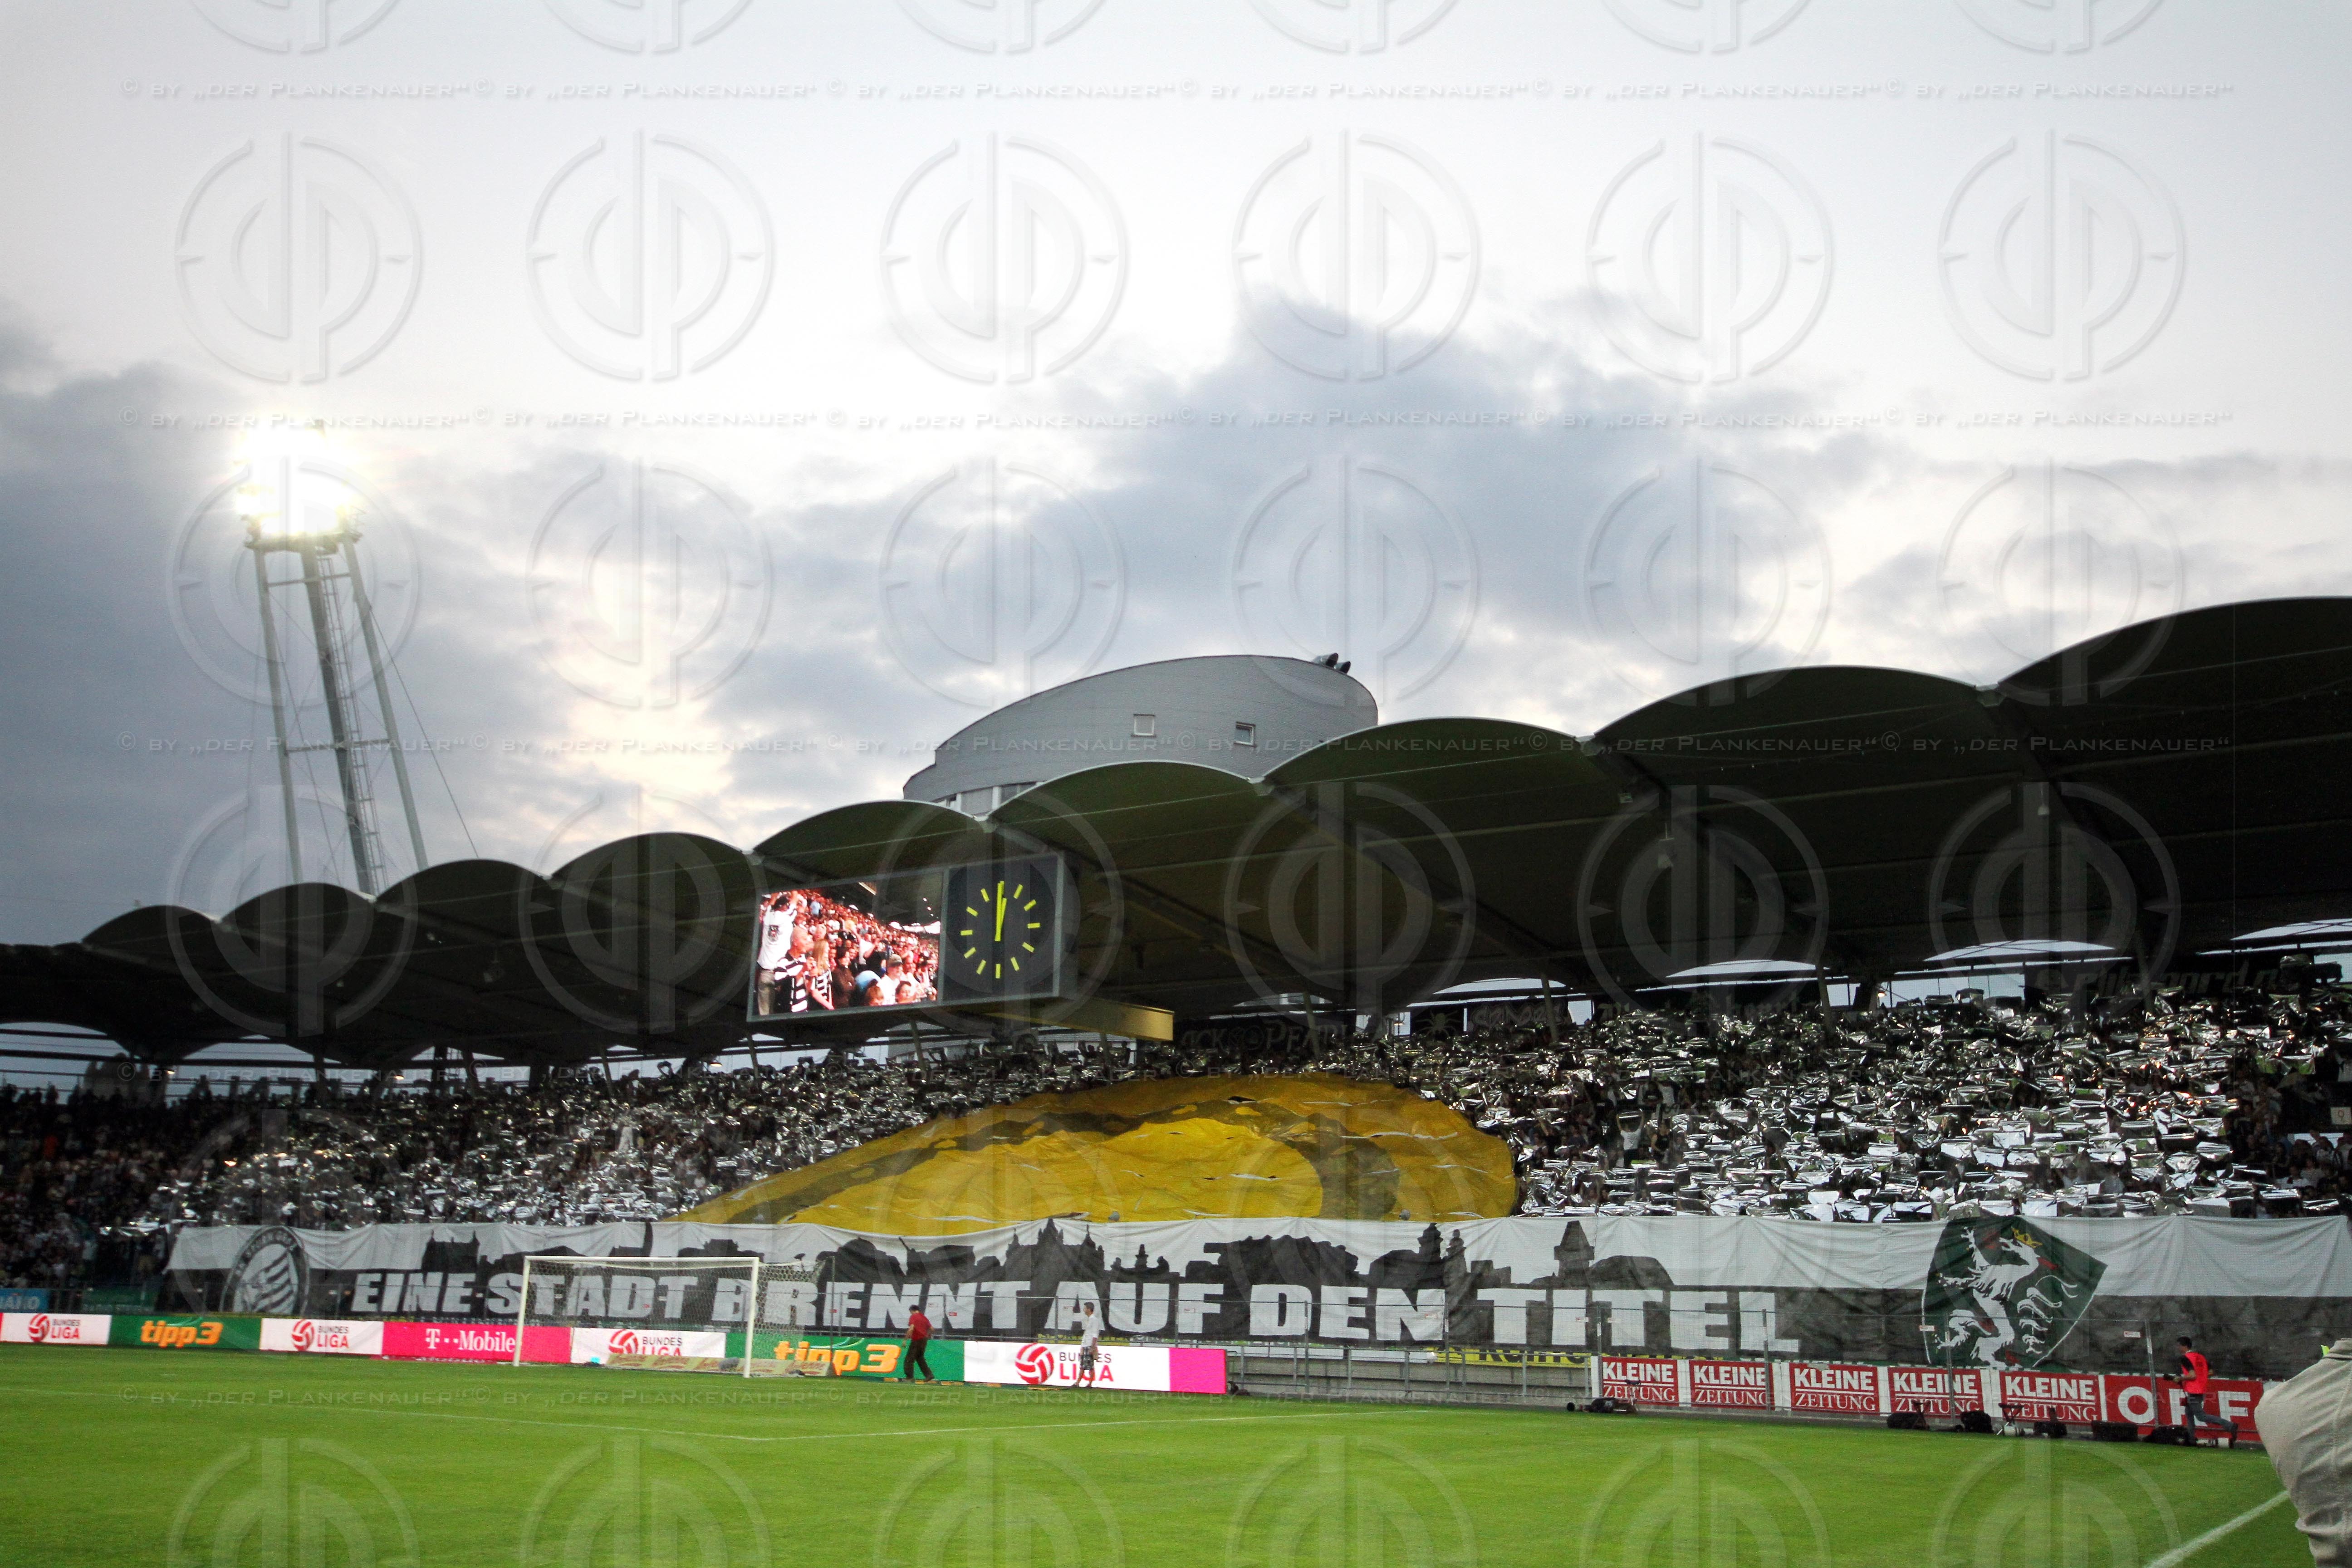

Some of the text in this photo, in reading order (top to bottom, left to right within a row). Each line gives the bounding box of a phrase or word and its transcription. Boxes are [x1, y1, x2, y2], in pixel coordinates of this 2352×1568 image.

[350, 1272, 1799, 1353] EINE STADT BRENNT AUF DEN TITEL
[52, 1318, 80, 1327] BUNDES
[318, 1325, 349, 1334] BUNDES
[51, 1327, 80, 1339] LIGA
[140, 1320, 224, 1348] tipp3
[317, 1333, 349, 1348] LIGA
[642, 1336, 682, 1346] BUNDES
[1059, 1352, 1112, 1363] BUES
[1602, 1361, 1674, 1382] KLEINE
[1693, 1364, 1766, 1386] KLEINE
[1794, 1367, 1874, 1392] KLEINE
[1892, 1372, 1978, 1394] KLEINE
[2004, 1375, 2095, 1401] KLEINE
[1602, 1384, 1676, 1402] ZEITUNG
[1795, 1392, 1876, 1411] ZEITUNG
